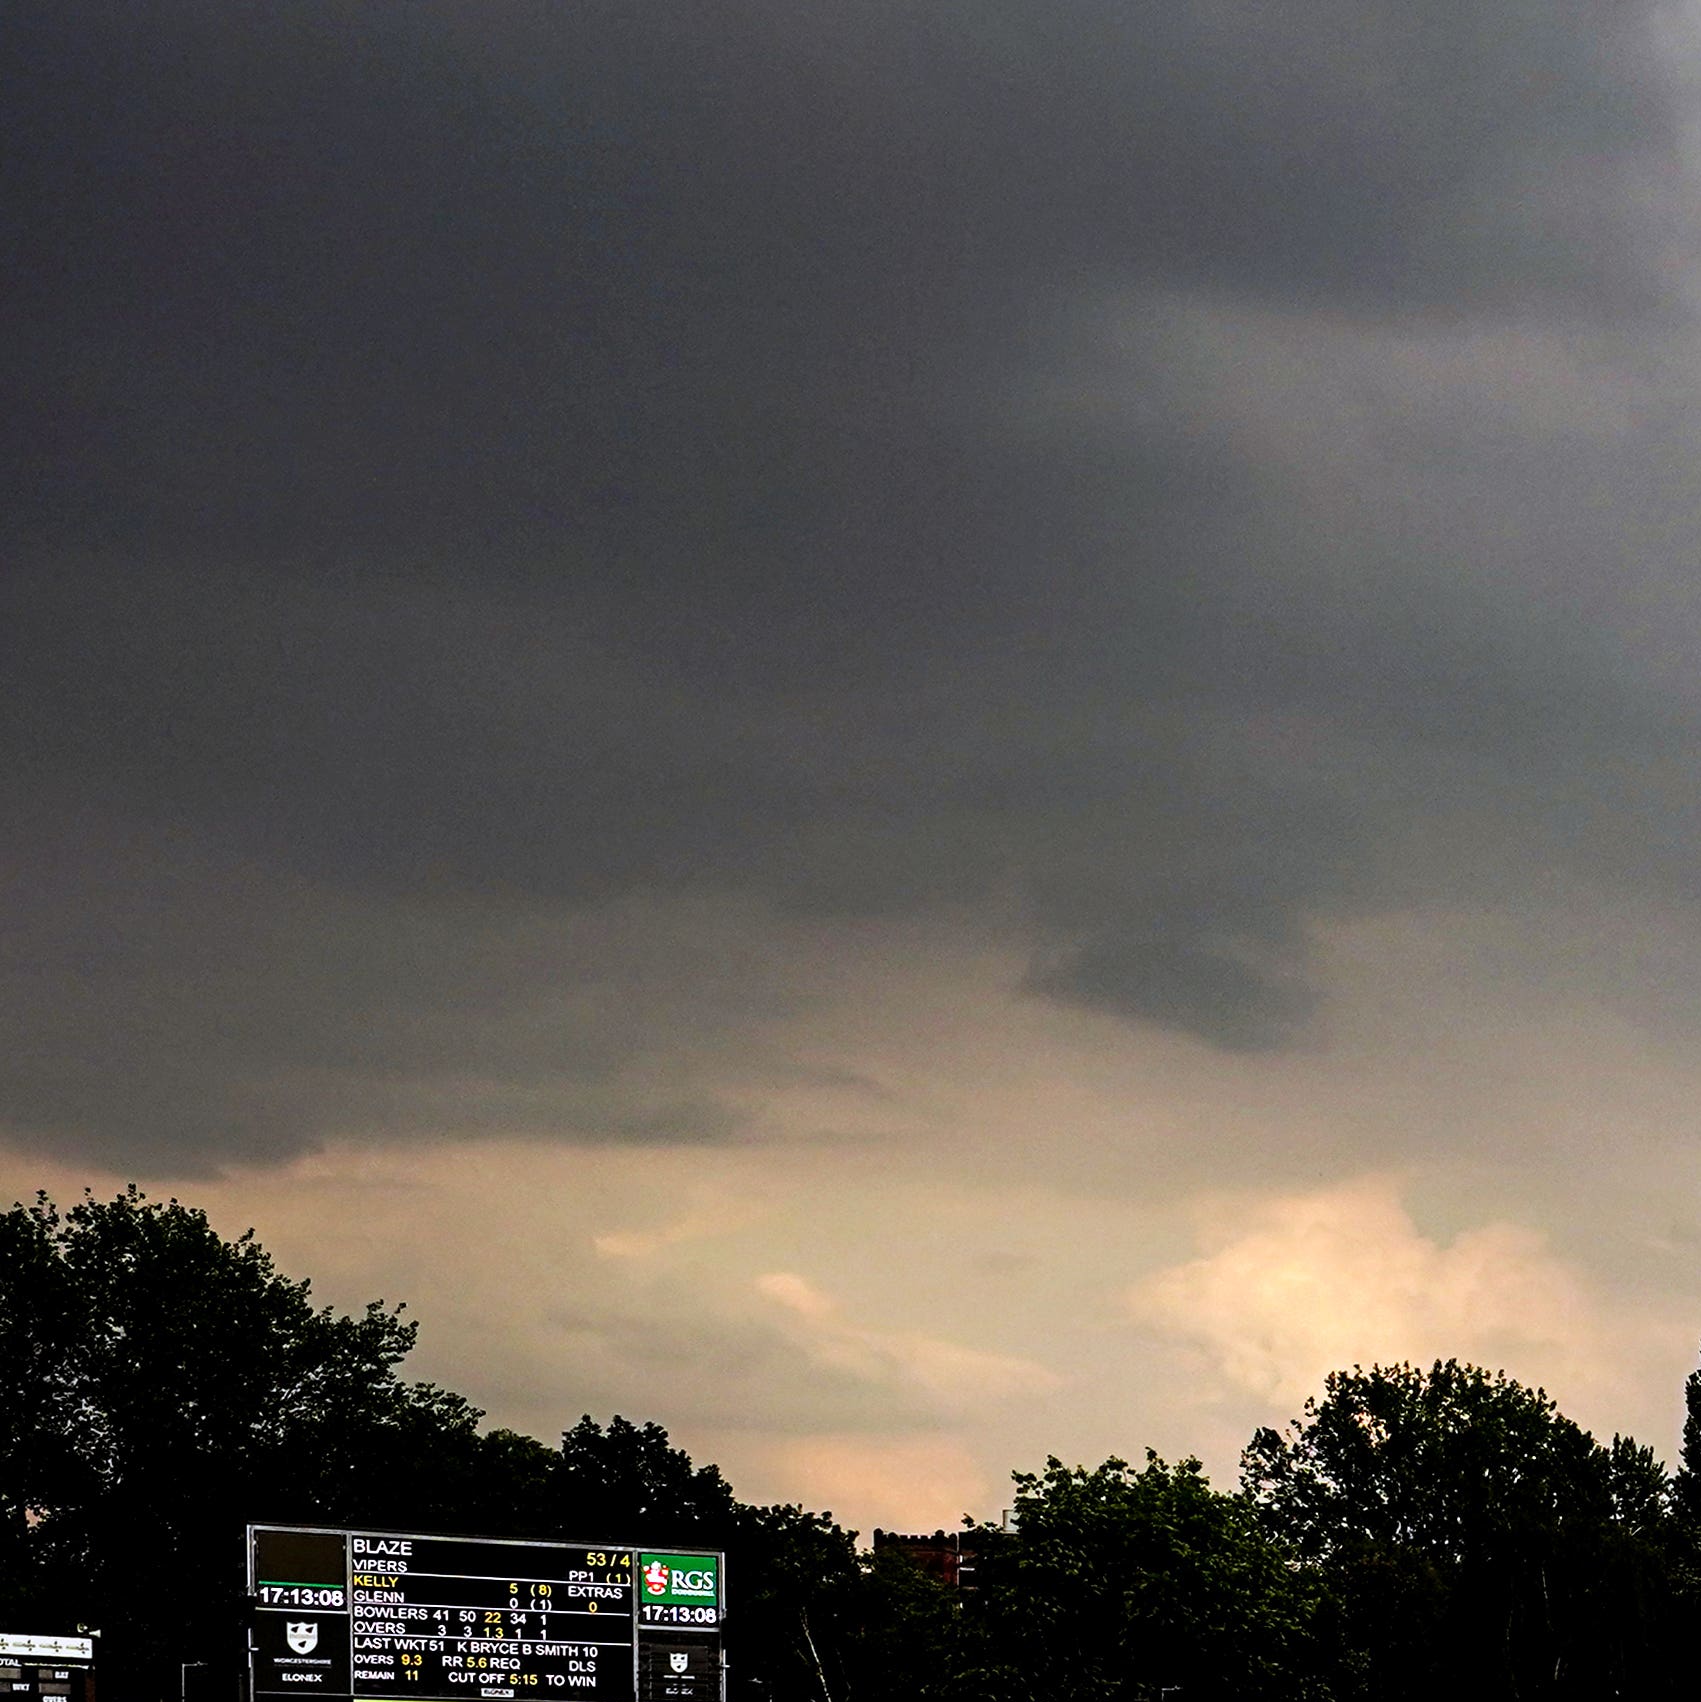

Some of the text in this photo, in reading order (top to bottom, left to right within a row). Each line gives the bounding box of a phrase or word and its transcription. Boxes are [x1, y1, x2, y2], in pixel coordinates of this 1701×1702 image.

[353, 1539, 413, 1556] BLAZE
[352, 1559, 408, 1572] VIPERS
[587, 1552, 607, 1566] 53
[569, 1570, 594, 1582] PP1
[671, 1570, 714, 1590] RGS
[258, 1586, 344, 1606] 17:13:08
[353, 1575, 399, 1587] KELLY
[509, 1583, 518, 1594] 5
[568, 1586, 623, 1599] EXTRAS
[353, 1590, 405, 1603] GLENN
[509, 1598, 518, 1609] 0
[588, 1601, 598, 1614] 0
[354, 1606, 547, 1625] BOWLERS 41 50 22 34 1
[642, 1605, 717, 1623] 17:13:08
[353, 1621, 406, 1634] OVERS
[437, 1624, 447, 1636] 3
[463, 1626, 473, 1638] 3
[515, 1628, 522, 1639] 1
[540, 1629, 547, 1640] 1
[354, 1637, 598, 1658] LAST WKT 51 K BRYCE B SMITH 10
[353, 1653, 596, 1672] OVERS 9.3 RR 5.6 REQ DLS
[281, 1673, 323, 1682] ELONEX
[353, 1669, 596, 1687] REMAIN 11 CUT OFF 5:15 TO WIN
